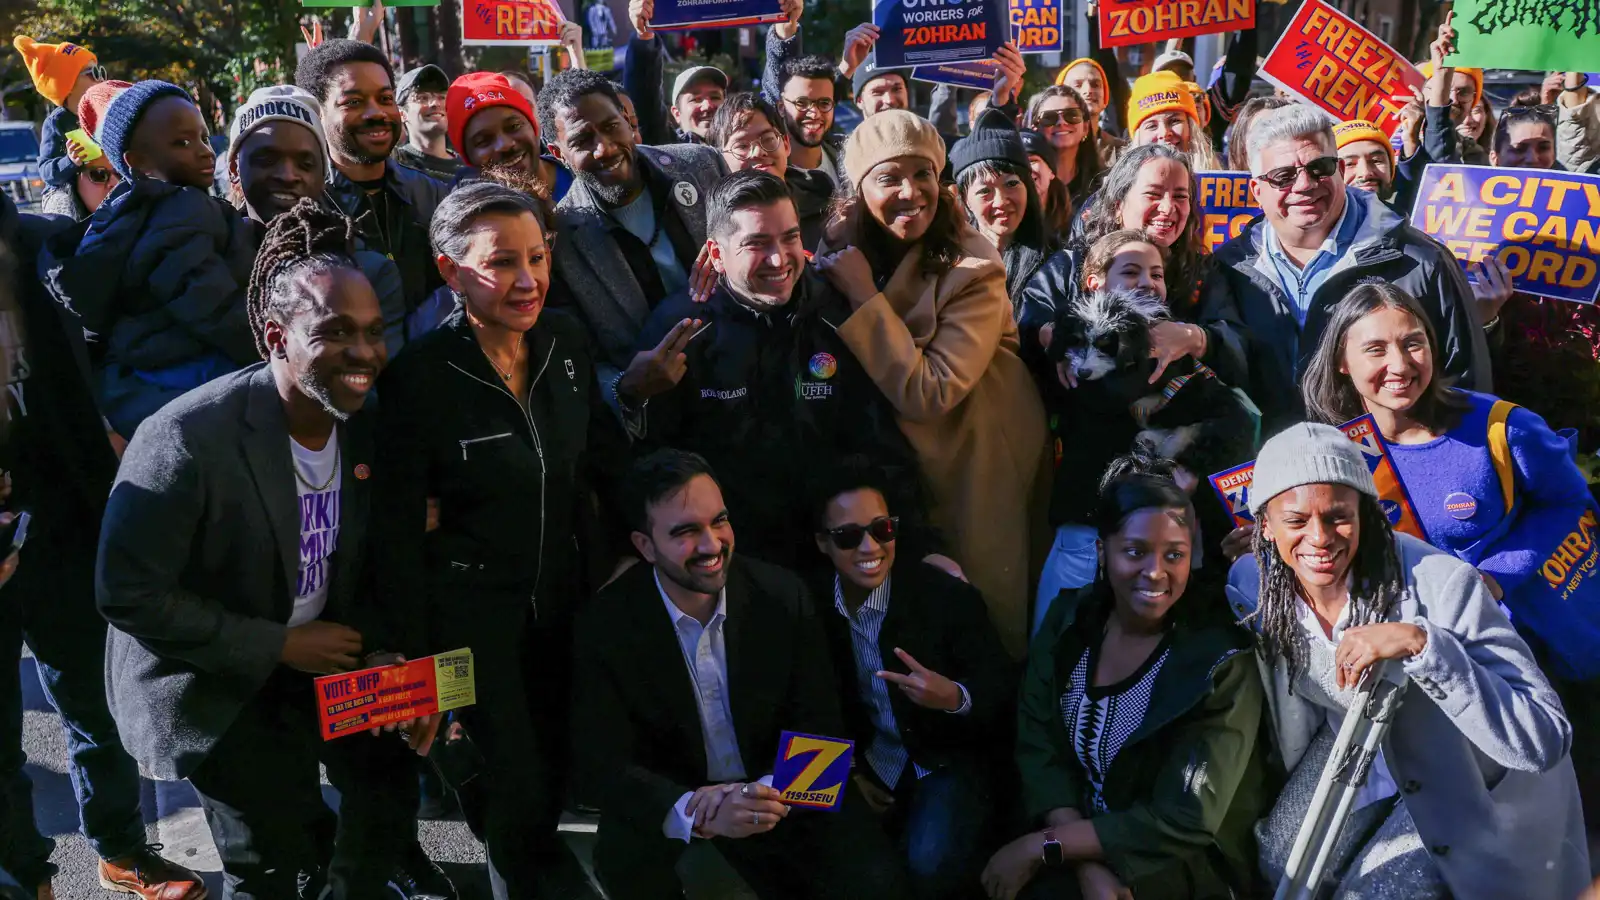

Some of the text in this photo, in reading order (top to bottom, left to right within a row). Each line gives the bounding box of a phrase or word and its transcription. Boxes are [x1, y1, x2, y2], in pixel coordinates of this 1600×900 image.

[475, 4, 493, 24] THE
[903, 5, 984, 24] WORKERS FOR
[1010, 8, 1058, 26] CAN
[1107, 0, 1250, 38] ZOHRAN
[903, 22, 987, 47] ZOHRAN
[1296, 41, 1312, 70] THE
[1300, 7, 1407, 95] FREEZE
[477, 91, 507, 102] DSA
[1302, 55, 1400, 129] RENT
[239, 101, 314, 134] BROOKLYN
[1429, 173, 1466, 202] A
[1425, 205, 1600, 256] WE CAN
[1443, 240, 1598, 289] FFORD
[801, 385, 833, 397] UFFH
[1221, 423, 1369, 489] DEMO OR
[1447, 502, 1475, 510] ZOHRAN
[1565, 570, 1583, 594] NEW
[324, 678, 351, 700] VOTE
[357, 672, 380, 692] WFP
[785, 790, 834, 803] 1199SEIU
